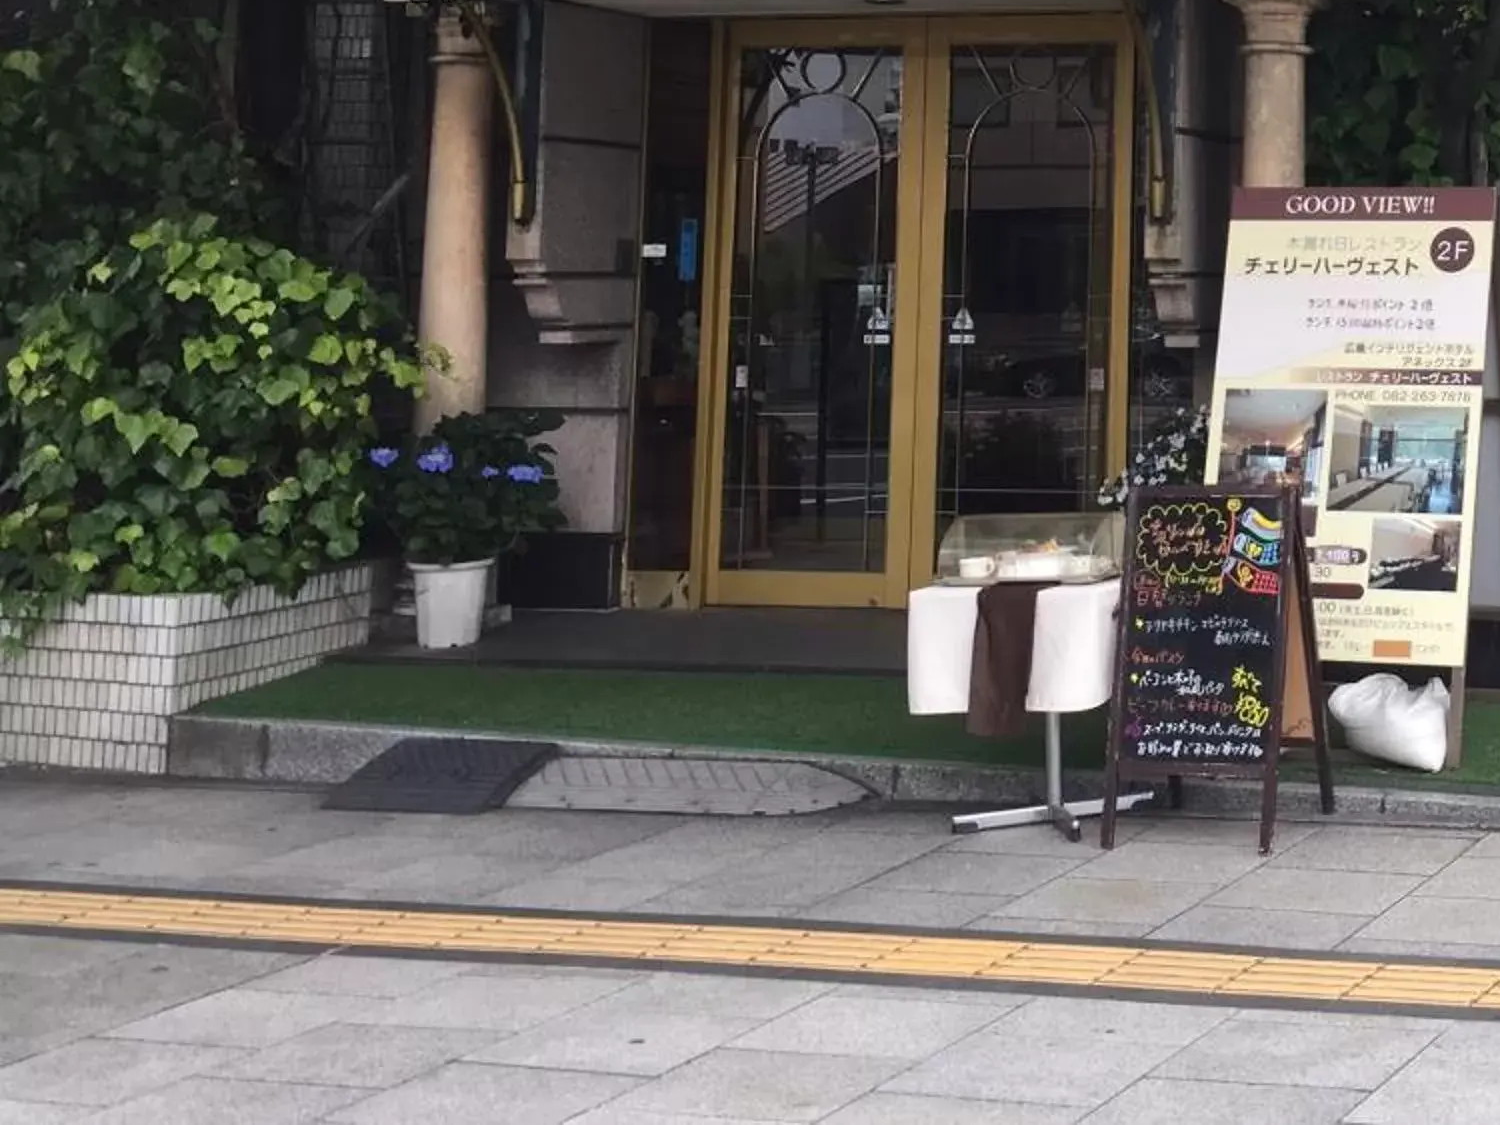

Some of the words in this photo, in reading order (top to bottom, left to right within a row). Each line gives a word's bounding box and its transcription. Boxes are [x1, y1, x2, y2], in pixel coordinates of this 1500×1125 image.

[1285, 196, 1355, 215] GOOD
[1362, 195, 1435, 215] VIEW!!
[1437, 240, 1469, 261] 2F
[1245, 257, 1419, 276] チェリーハーヴェスト
[1369, 371, 1472, 384] チェリーハーヴェスト
[1335, 390, 1375, 401] PHONE
